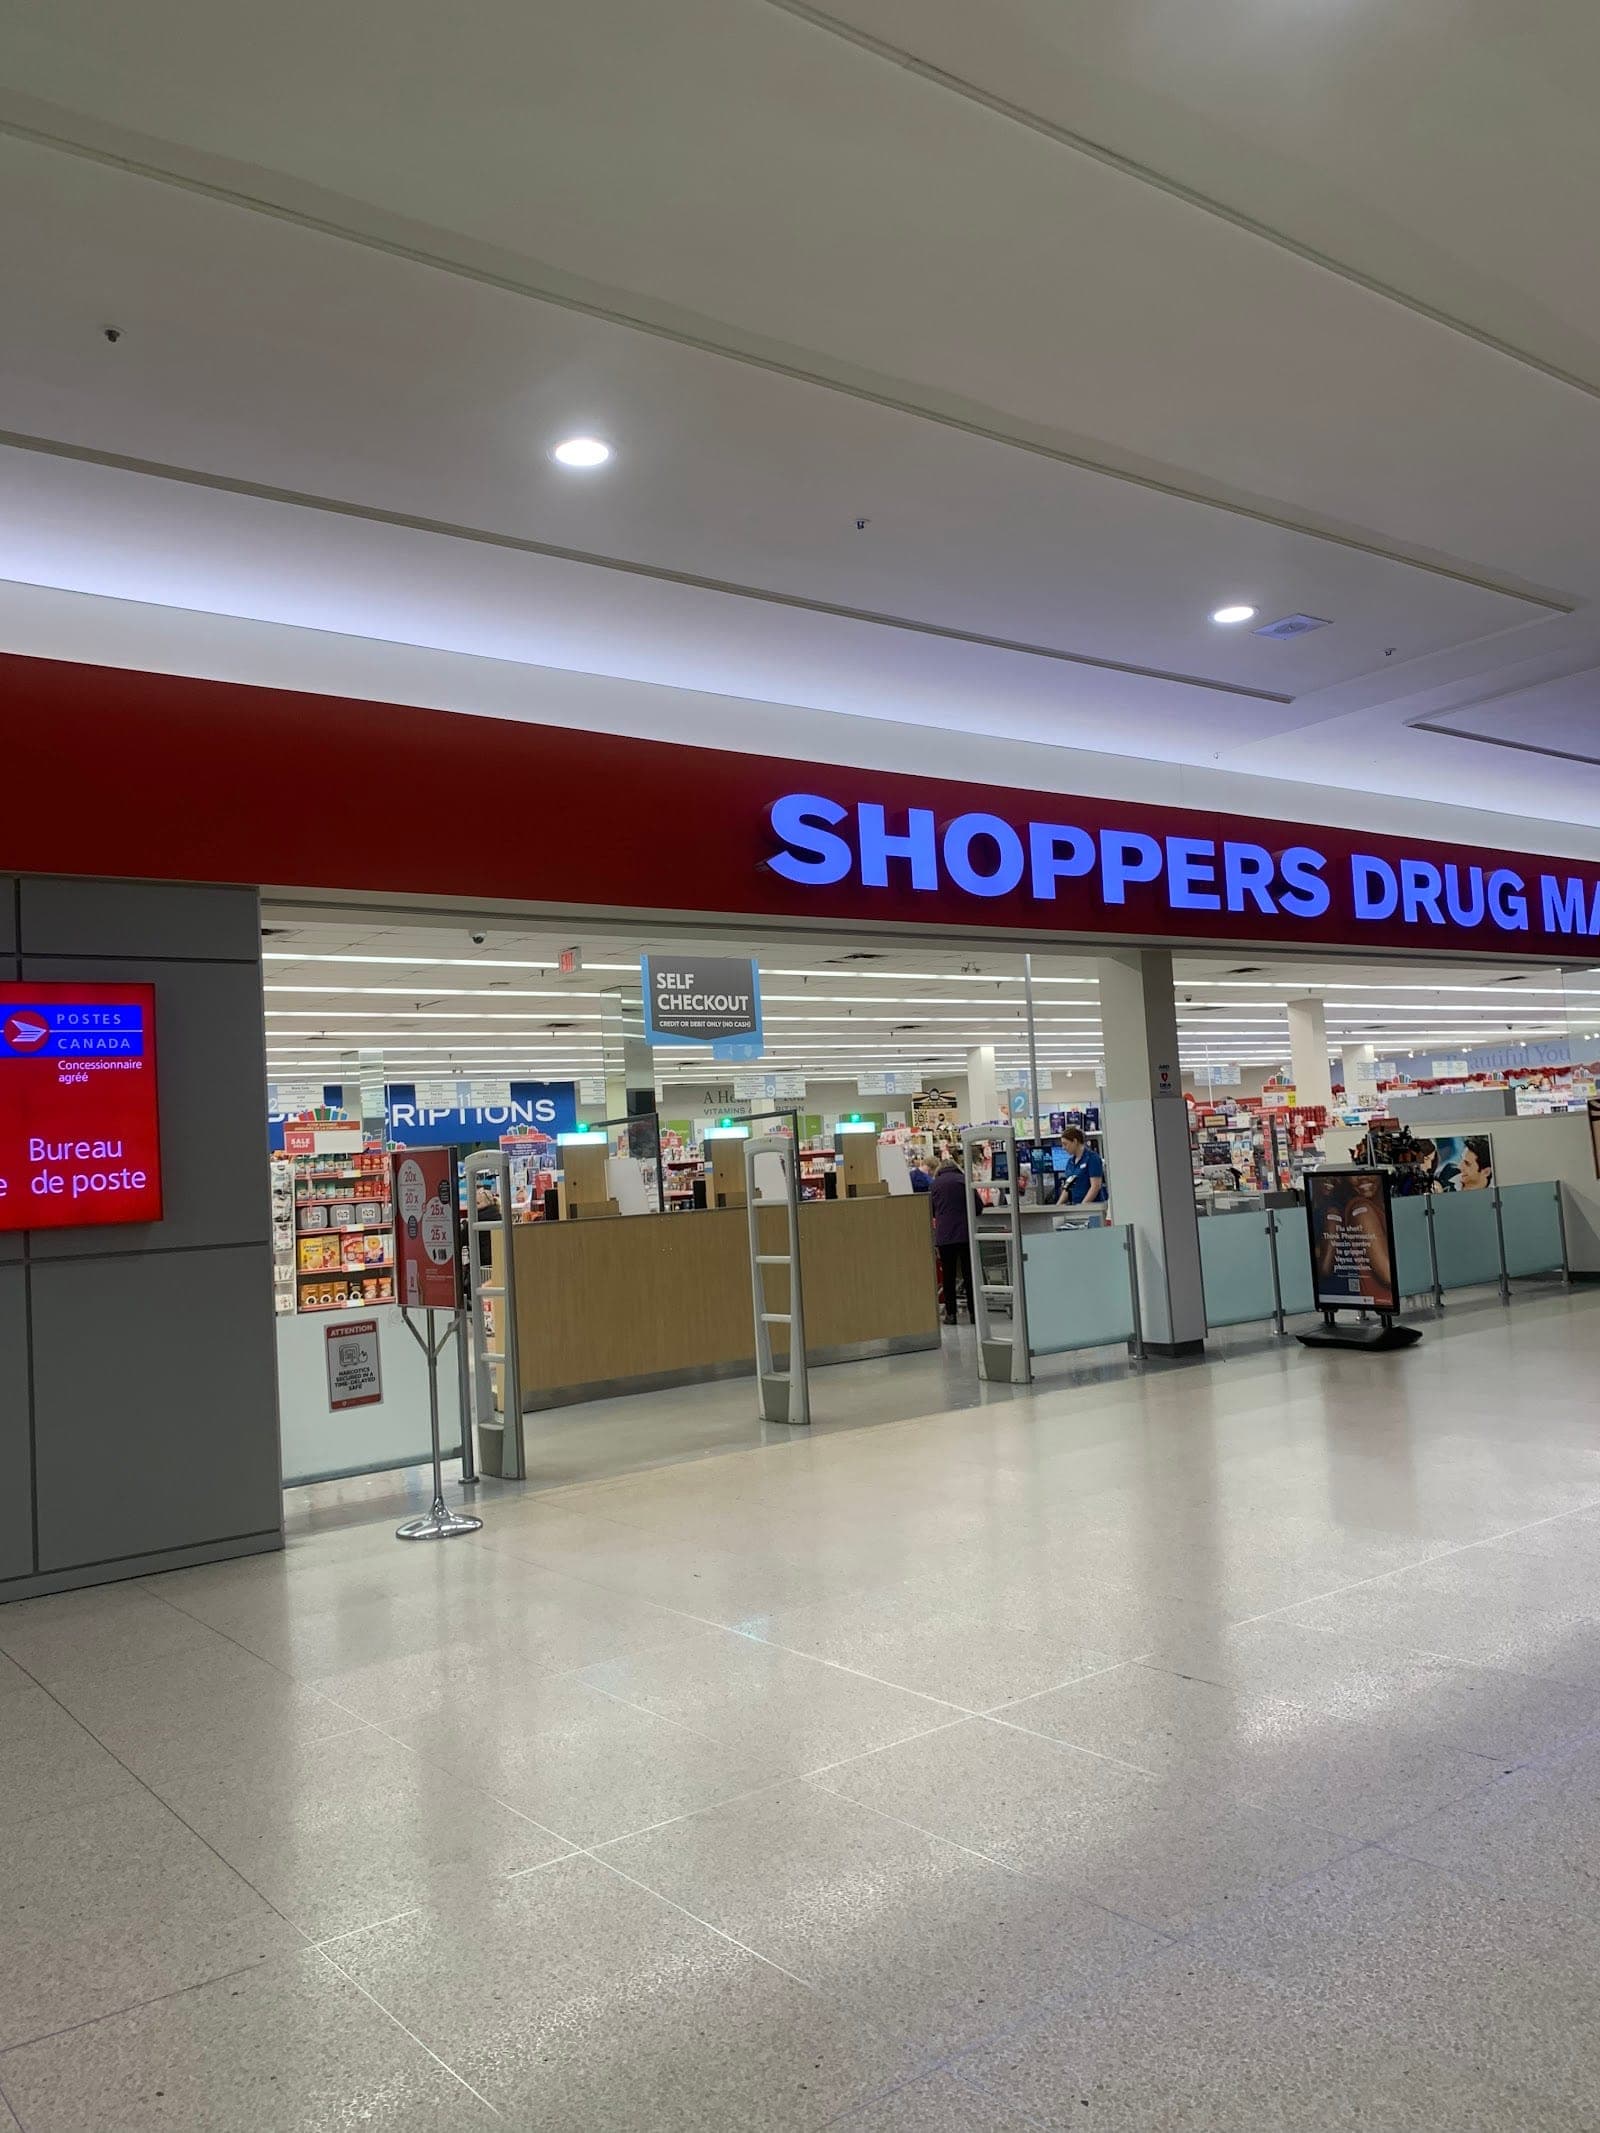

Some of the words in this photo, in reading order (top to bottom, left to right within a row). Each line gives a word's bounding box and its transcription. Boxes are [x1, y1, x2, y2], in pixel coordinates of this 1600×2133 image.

[768, 794, 1330, 918] SHOPPERS
[1351, 854, 1528, 930] DRUG
[656, 973, 695, 990] SELF
[657, 994, 749, 1011] CHECKOUT
[57, 1013, 121, 1025] POSTES
[57, 1038, 131, 1049] CANADA
[1447, 1045, 1530, 1070] autiful
[1534, 1044, 1571, 1062] You
[57, 1059, 143, 1070] Concessionnaire
[58, 1072, 89, 1084] agréé
[766, 1084, 776, 1098] 9
[886, 1082, 895, 1094] 8
[459, 1094, 470, 1107] 11
[703, 1091, 714, 1104] A
[1014, 1096, 1025, 1112] 2
[385, 1099, 556, 1128] RIPTIONS
[29, 1138, 122, 1162] Bureau
[31, 1169, 64, 1194] de
[72, 1168, 146, 1198] poste
[431, 1204, 444, 1216] 25x
[331, 1325, 373, 1336] ATTENTION
